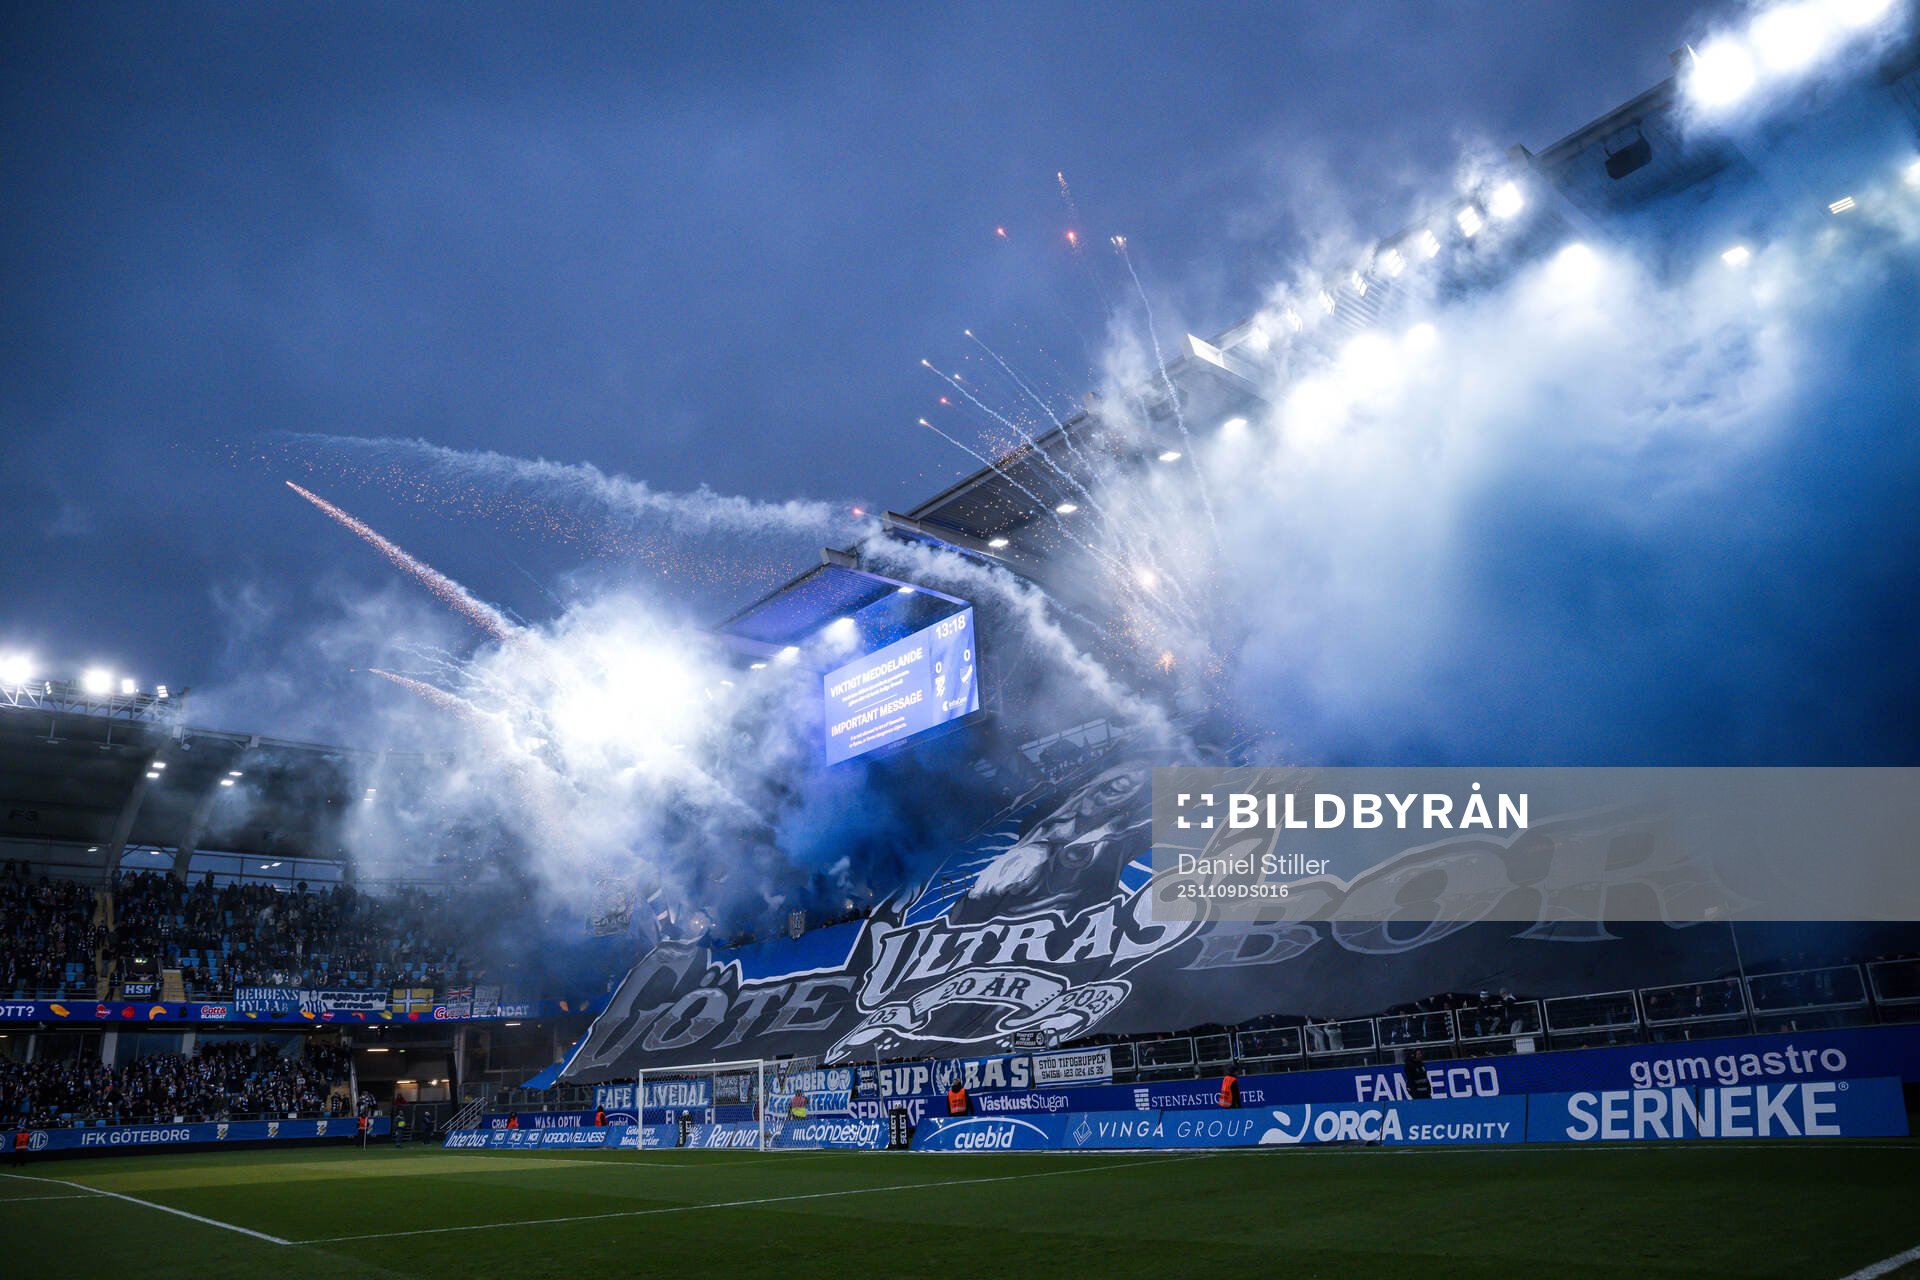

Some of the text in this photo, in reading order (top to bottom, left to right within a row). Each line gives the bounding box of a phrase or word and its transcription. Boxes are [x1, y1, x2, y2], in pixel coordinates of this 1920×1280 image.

[935, 615, 966, 640] 13:18
[963, 649, 971, 662] 0
[830, 674, 861, 698] VIKTIGT
[862, 647, 923, 686] MEDDELANDE
[935, 661, 943, 674] 0
[831, 708, 878, 737] IMPORTANT
[880, 690, 923, 717] MESSAGE
[863, 873, 1198, 1006] ULTRAS
[235, 988, 299, 1000] BEBBENS
[939, 978, 976, 1001] 20
[1038, 1053, 1106, 1070] STÖD TIFOGRUPPEN
[1064, 1068, 1073, 1078] 123
[1151, 1089, 1265, 1107] STENFASTITER
[535, 1115, 581, 1128] WASA OPTIK
[899, 1113, 907, 1145] SELECT
[1099, 1119, 1254, 1138] VINGA GROUP
[1313, 1109, 1511, 1141] ORCA SECURITY
[81, 1128, 190, 1145] IFK GÖTEBORG
[445, 1130, 488, 1147] Interbus
[704, 1124, 760, 1148] Renova
[955, 1125, 1015, 1148] cuebid
